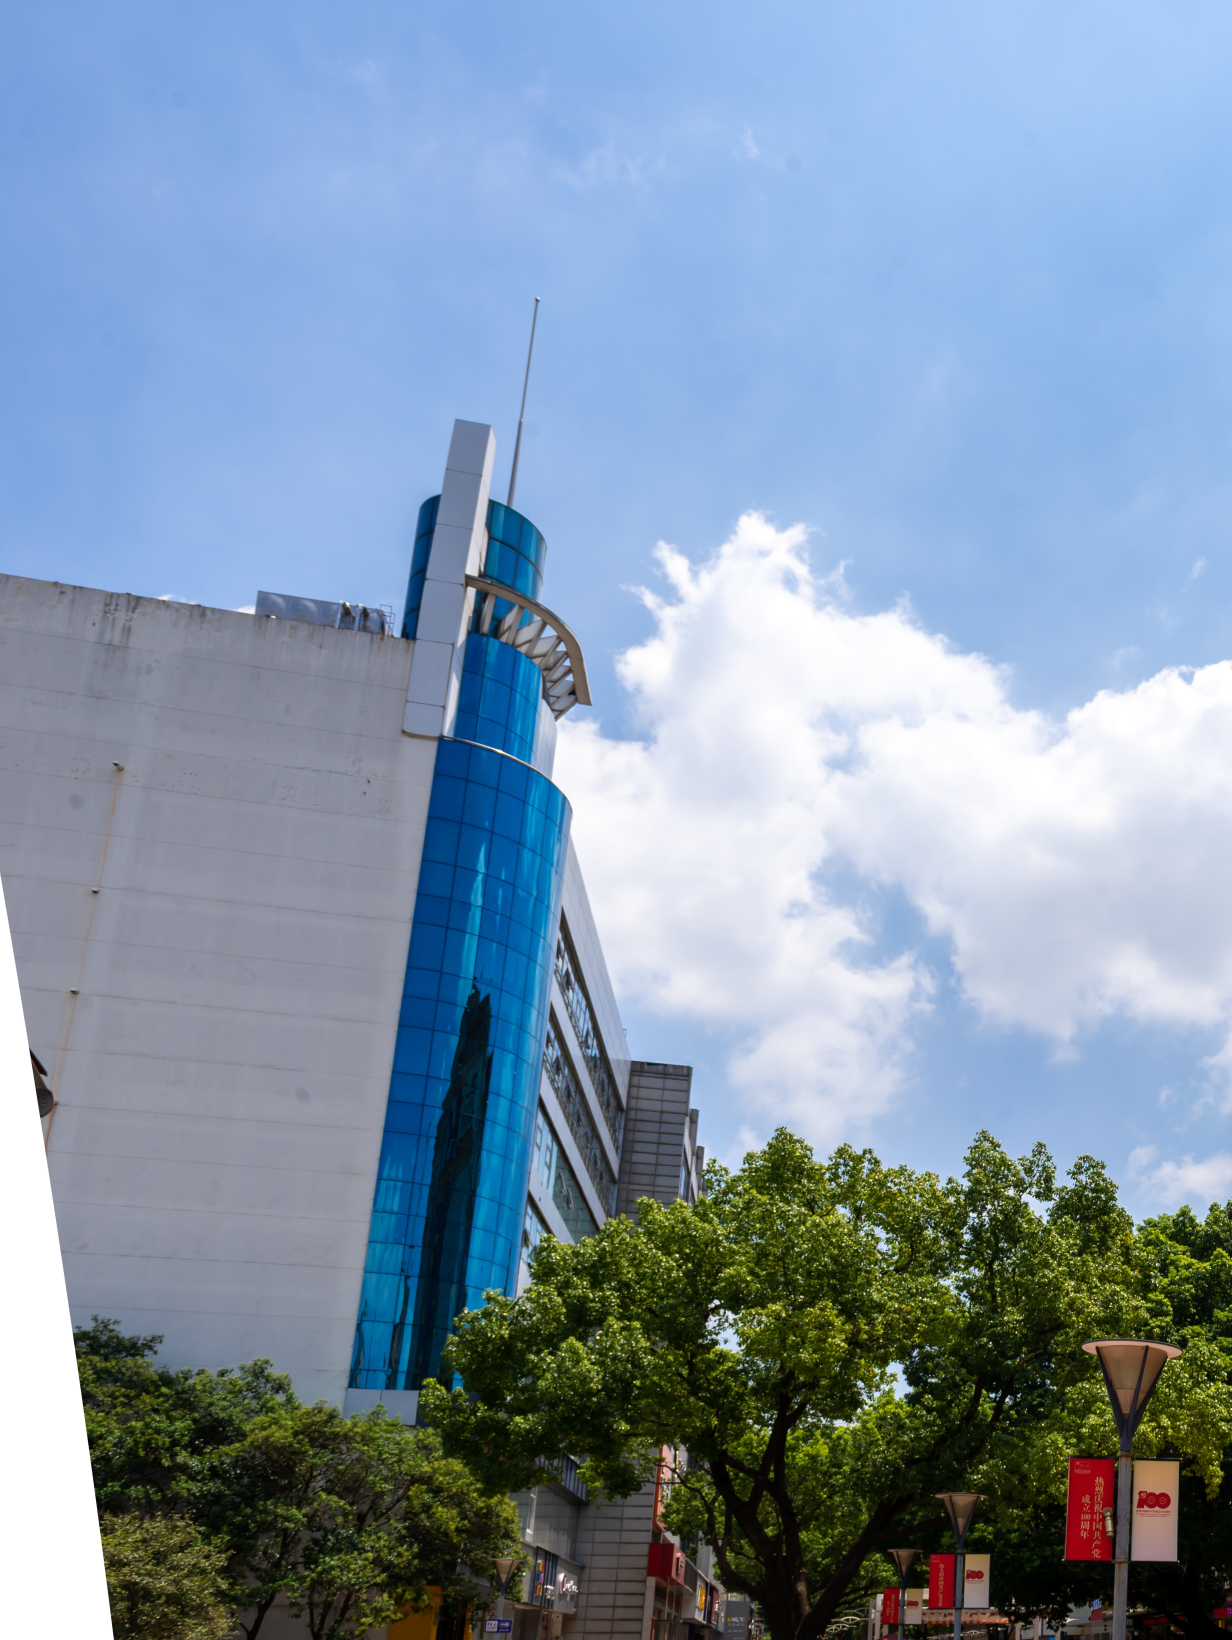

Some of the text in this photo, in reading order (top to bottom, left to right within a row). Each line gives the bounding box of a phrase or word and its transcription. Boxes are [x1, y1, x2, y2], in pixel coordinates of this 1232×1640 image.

[1080, 1494, 1091, 1540] 成立100周年
[1092, 1476, 1104, 1558] 热烈庆祝中国共产党
[1136, 1490, 1171, 1509] 100
